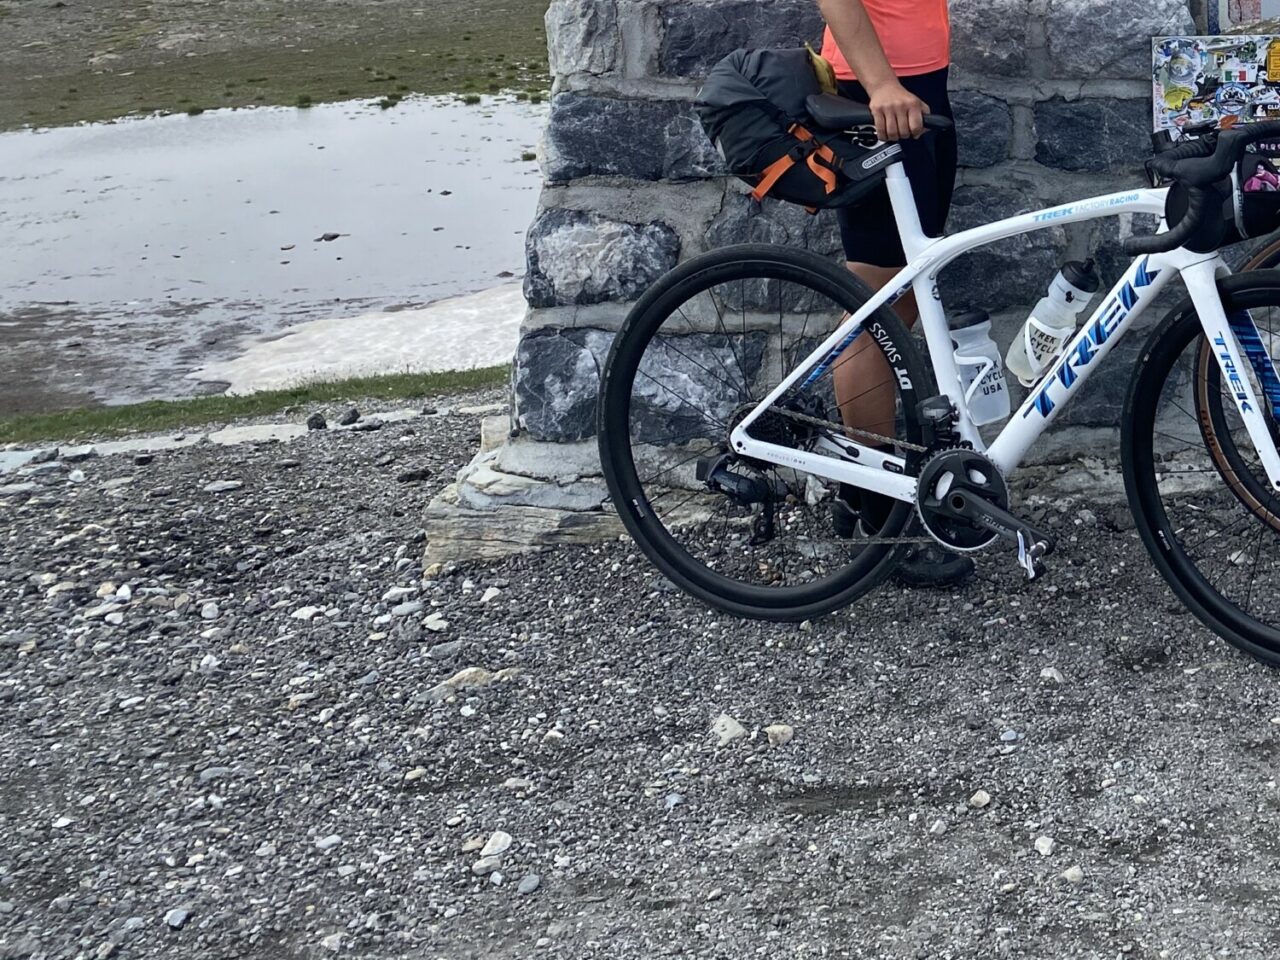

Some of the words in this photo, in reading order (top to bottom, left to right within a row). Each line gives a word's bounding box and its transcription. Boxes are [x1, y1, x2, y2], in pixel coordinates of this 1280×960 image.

[1032, 207, 1073, 222] TREK
[1109, 193, 1140, 206] RACING
[869, 323, 902, 363] SWISS
[1023, 254, 1162, 418] TREK
[894, 367, 913, 390] DT
[983, 382, 1003, 396] USA
[1214, 331, 1255, 415] TREK
